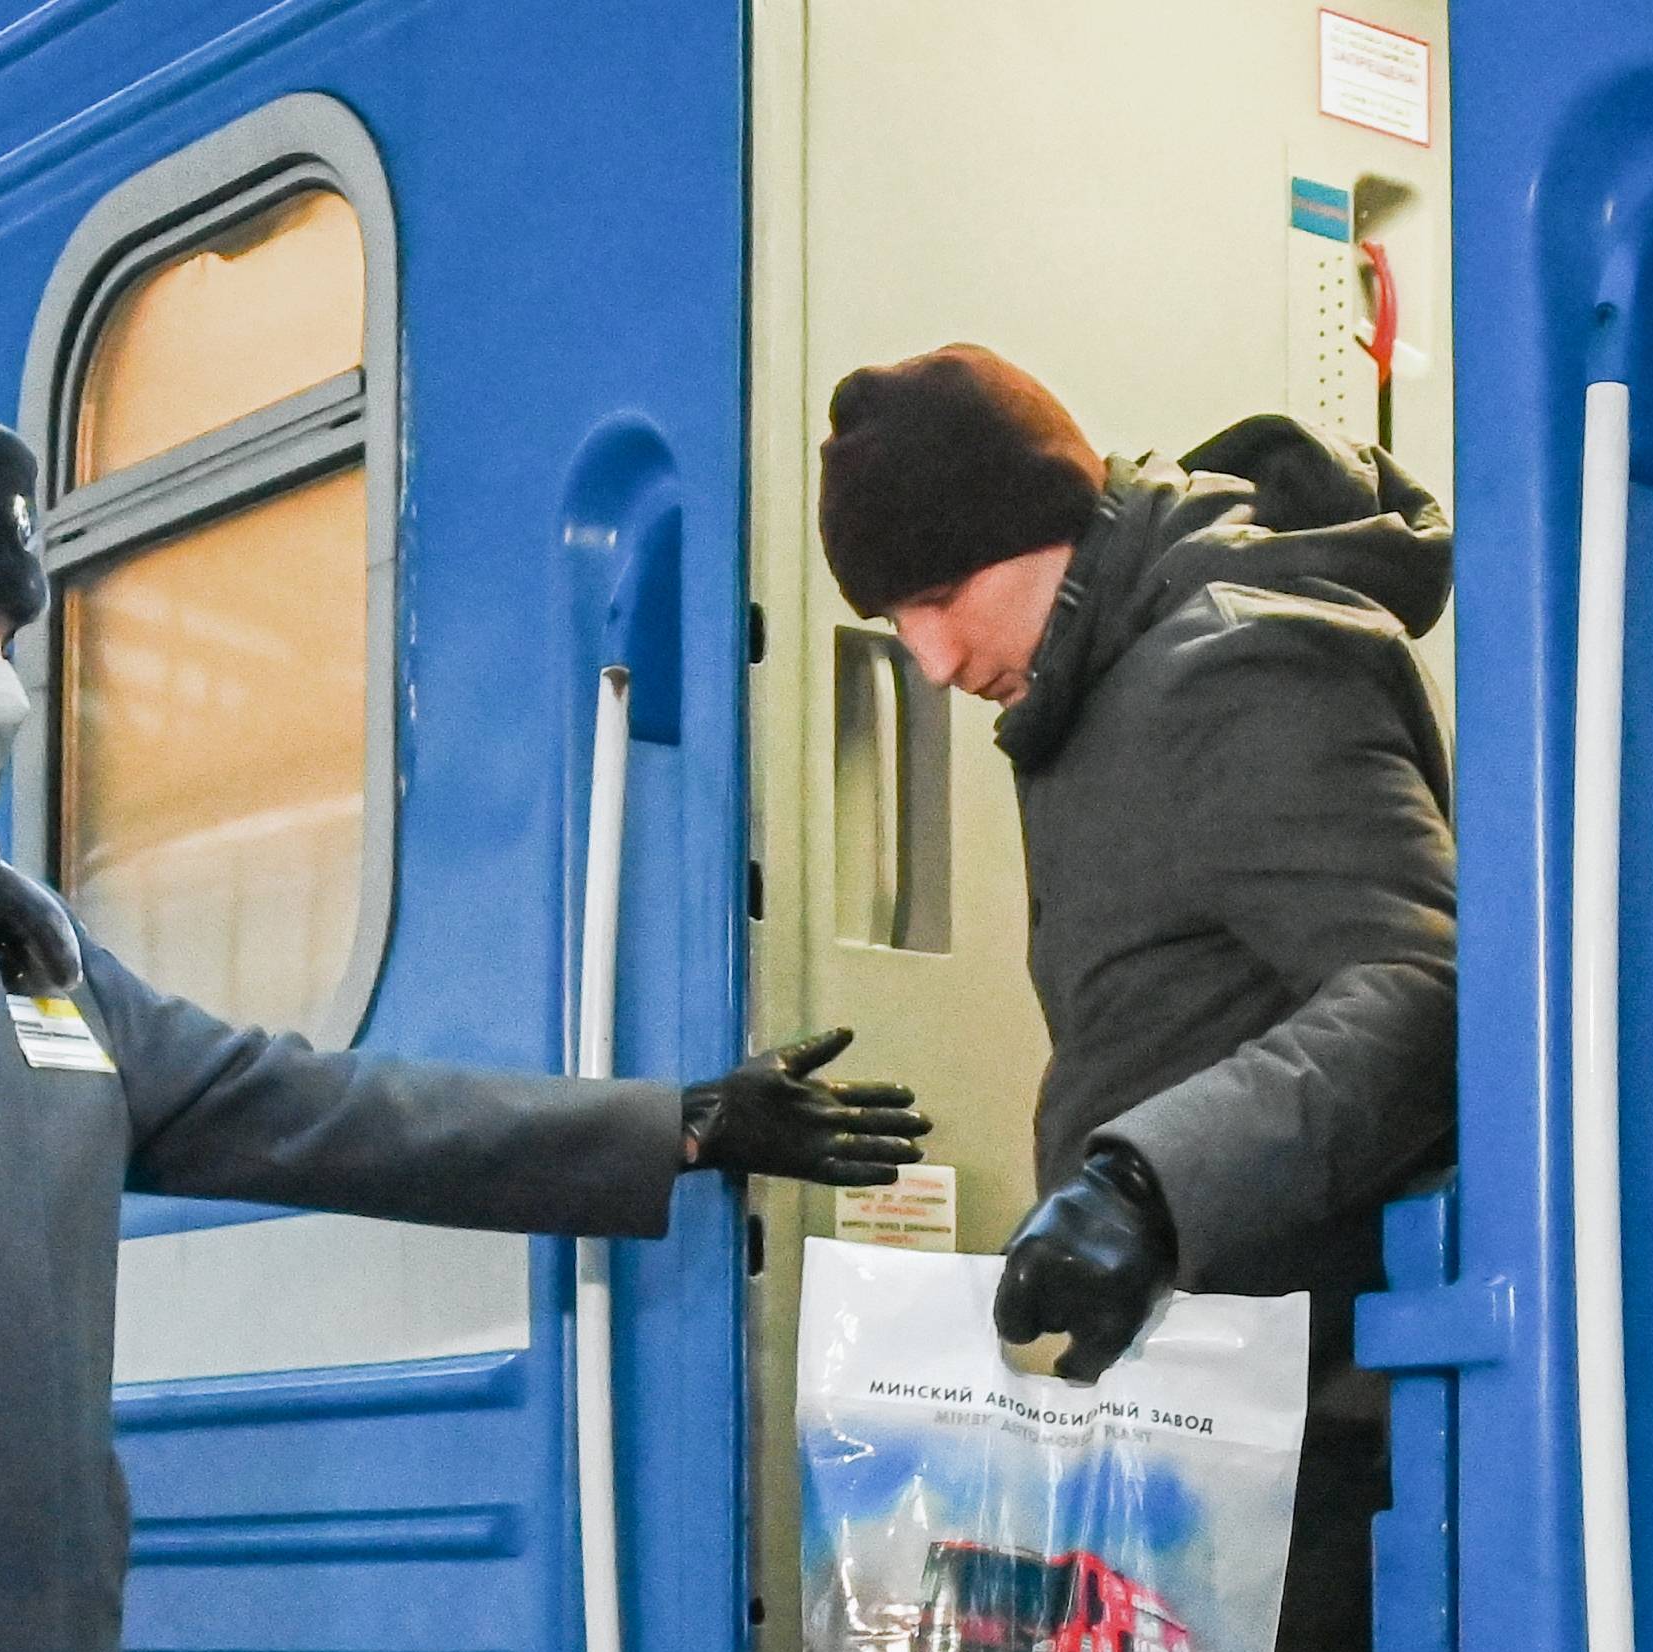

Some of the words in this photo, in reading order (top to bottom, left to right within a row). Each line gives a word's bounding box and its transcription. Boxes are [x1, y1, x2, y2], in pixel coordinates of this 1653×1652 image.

[869, 1380, 973, 1403] МИНСКИЙ
[985, 1391, 1139, 1426] АВТОМОБИЛНЫЙ
[1151, 1409, 1213, 1434] ЗАВОД
